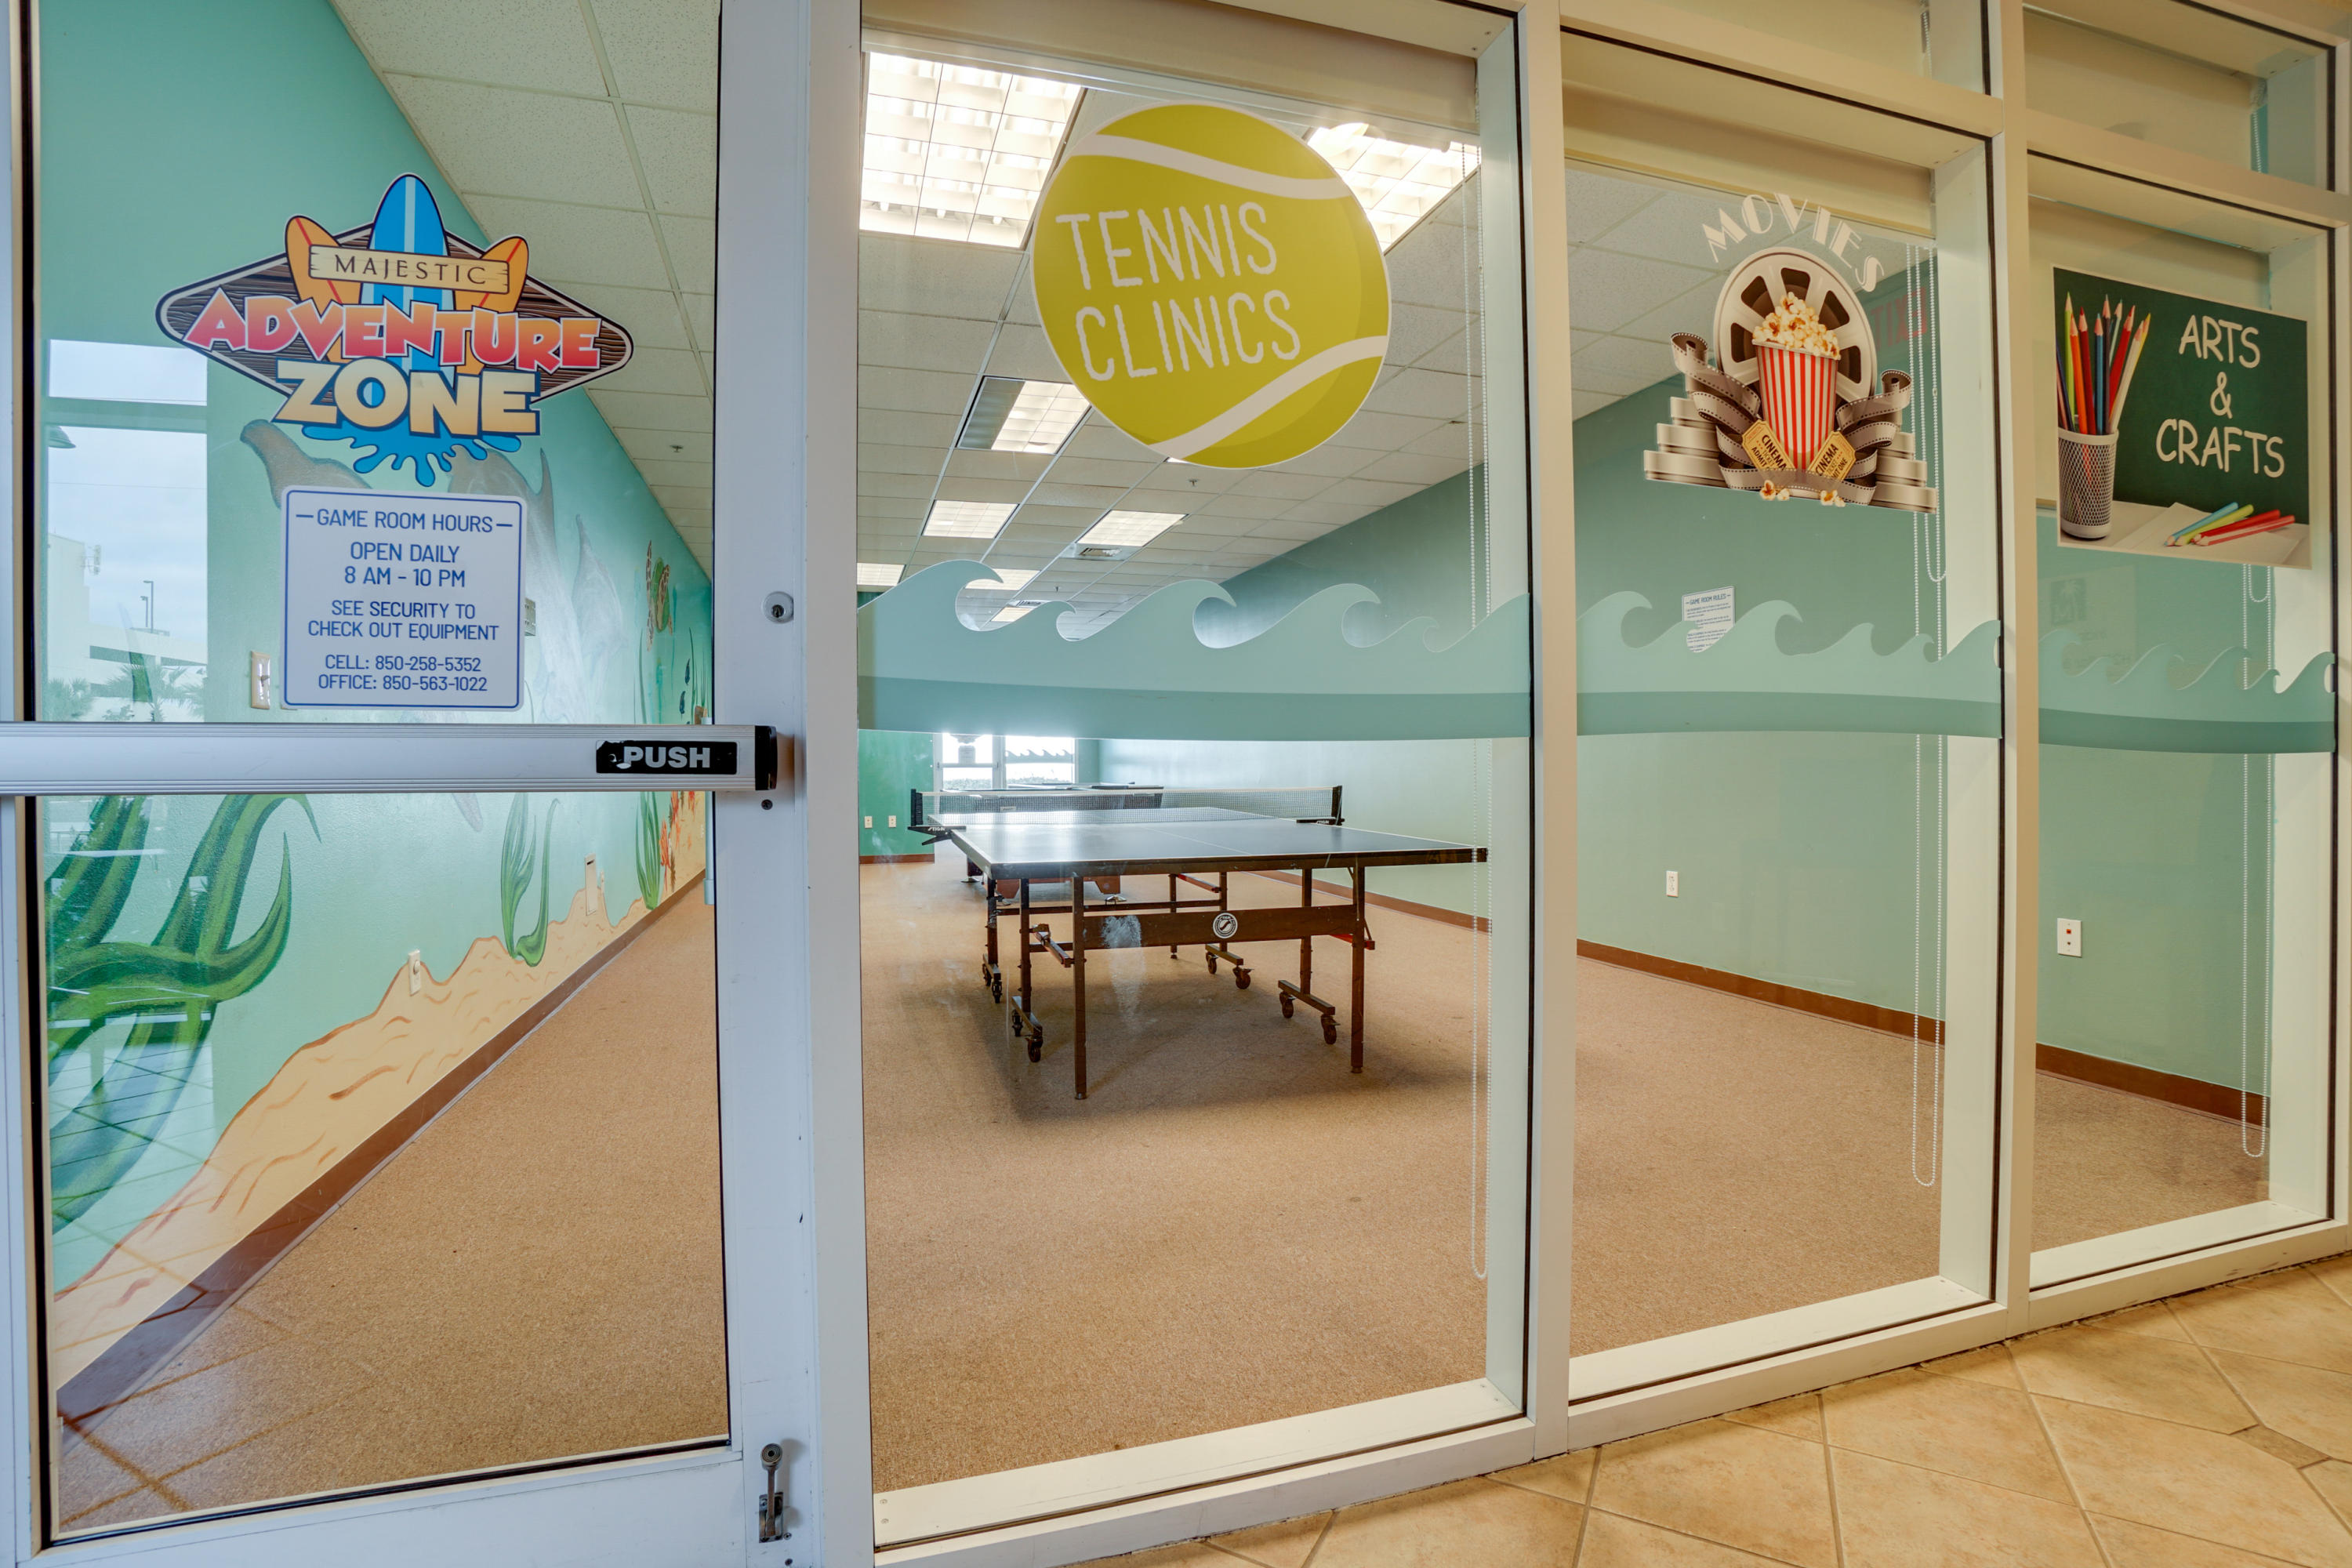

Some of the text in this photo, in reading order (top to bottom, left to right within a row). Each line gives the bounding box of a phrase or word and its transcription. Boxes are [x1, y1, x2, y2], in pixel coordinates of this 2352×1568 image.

[1055, 201, 1276, 290] TENNIS
[1702, 193, 1885, 292] MOVIES
[335, 253, 488, 286] MAJESTIC
[183, 287, 602, 375] ADVENTURE
[1076, 289, 1301, 381] CLINICS
[2179, 314, 2260, 368] ARTS
[271, 357, 541, 437] ZONE
[2210, 372, 2233, 419] &
[1751, 447, 1767, 467] ADMIT
[1762, 434, 1787, 471] CINEMA
[1816, 444, 1838, 476] CINEMA
[2156, 419, 2285, 478] CRAFTS
[317, 509, 493, 532] GAME ROOM HOURS
[350, 542, 459, 563] OPEN DAILY
[344, 567, 356, 584] 8
[363, 568, 390, 585] AM
[413, 568, 431, 586] 10
[439, 570, 465, 587] PM
[332, 601, 475, 619] SEE SECURITY TO
[308, 621, 499, 641] CHECK OUT EQUIPMENT
[325, 655, 481, 672] CELL: 850-258-5352
[318, 674, 488, 691] OFFICE: 850-563-1022
[623, 746, 711, 768] PUSH
